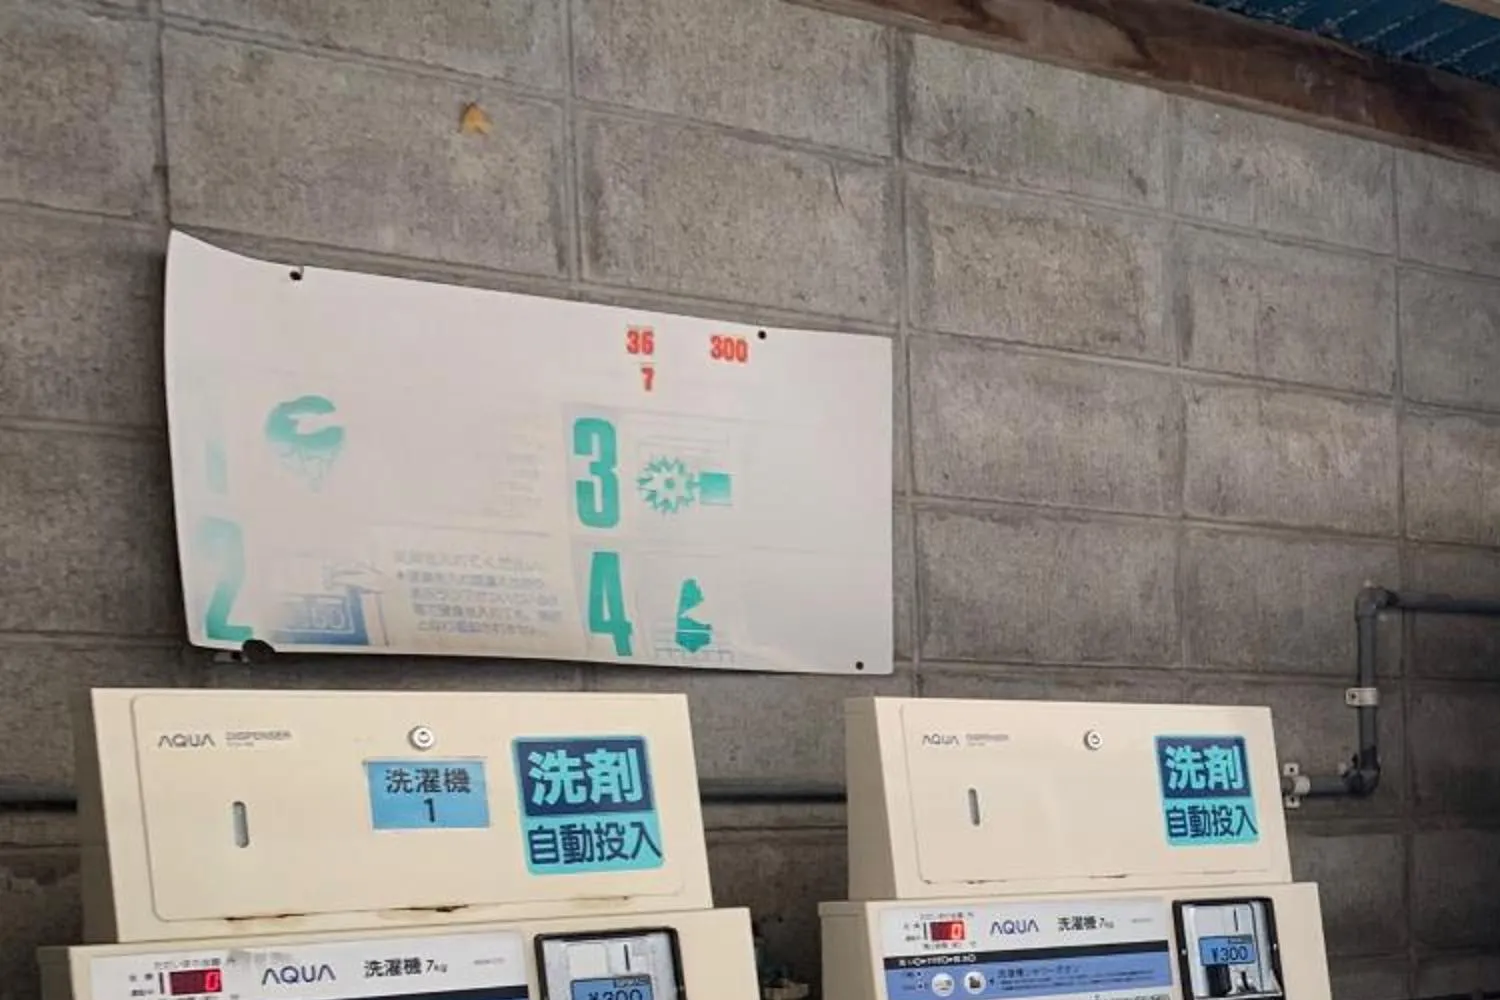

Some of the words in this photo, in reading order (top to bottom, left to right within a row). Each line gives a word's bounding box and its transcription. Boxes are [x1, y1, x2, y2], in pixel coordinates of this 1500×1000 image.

[627, 331, 654, 355] 36
[711, 335, 748, 363] 300
[641, 367, 655, 391] 7
[573, 417, 620, 529] 3
[588, 551, 633, 657] 4
[158, 733, 215, 748] AQUA
[922, 733, 960, 746] AQUA
[528, 748, 644, 805] 洗剤
[1165, 745, 1244, 790] 洗剤
[385, 768, 471, 794] 洗濯機
[424, 798, 435, 823] 1
[1166, 805, 1258, 838] 自動投入
[528, 821, 662, 865] 自動投入
[990, 918, 1039, 936] AQUA
[1058, 915, 1097, 932] 洗濯機
[262, 963, 337, 986] AQUA
[364, 957, 422, 979] 洗濯機
[205, 971, 219, 992] 0
